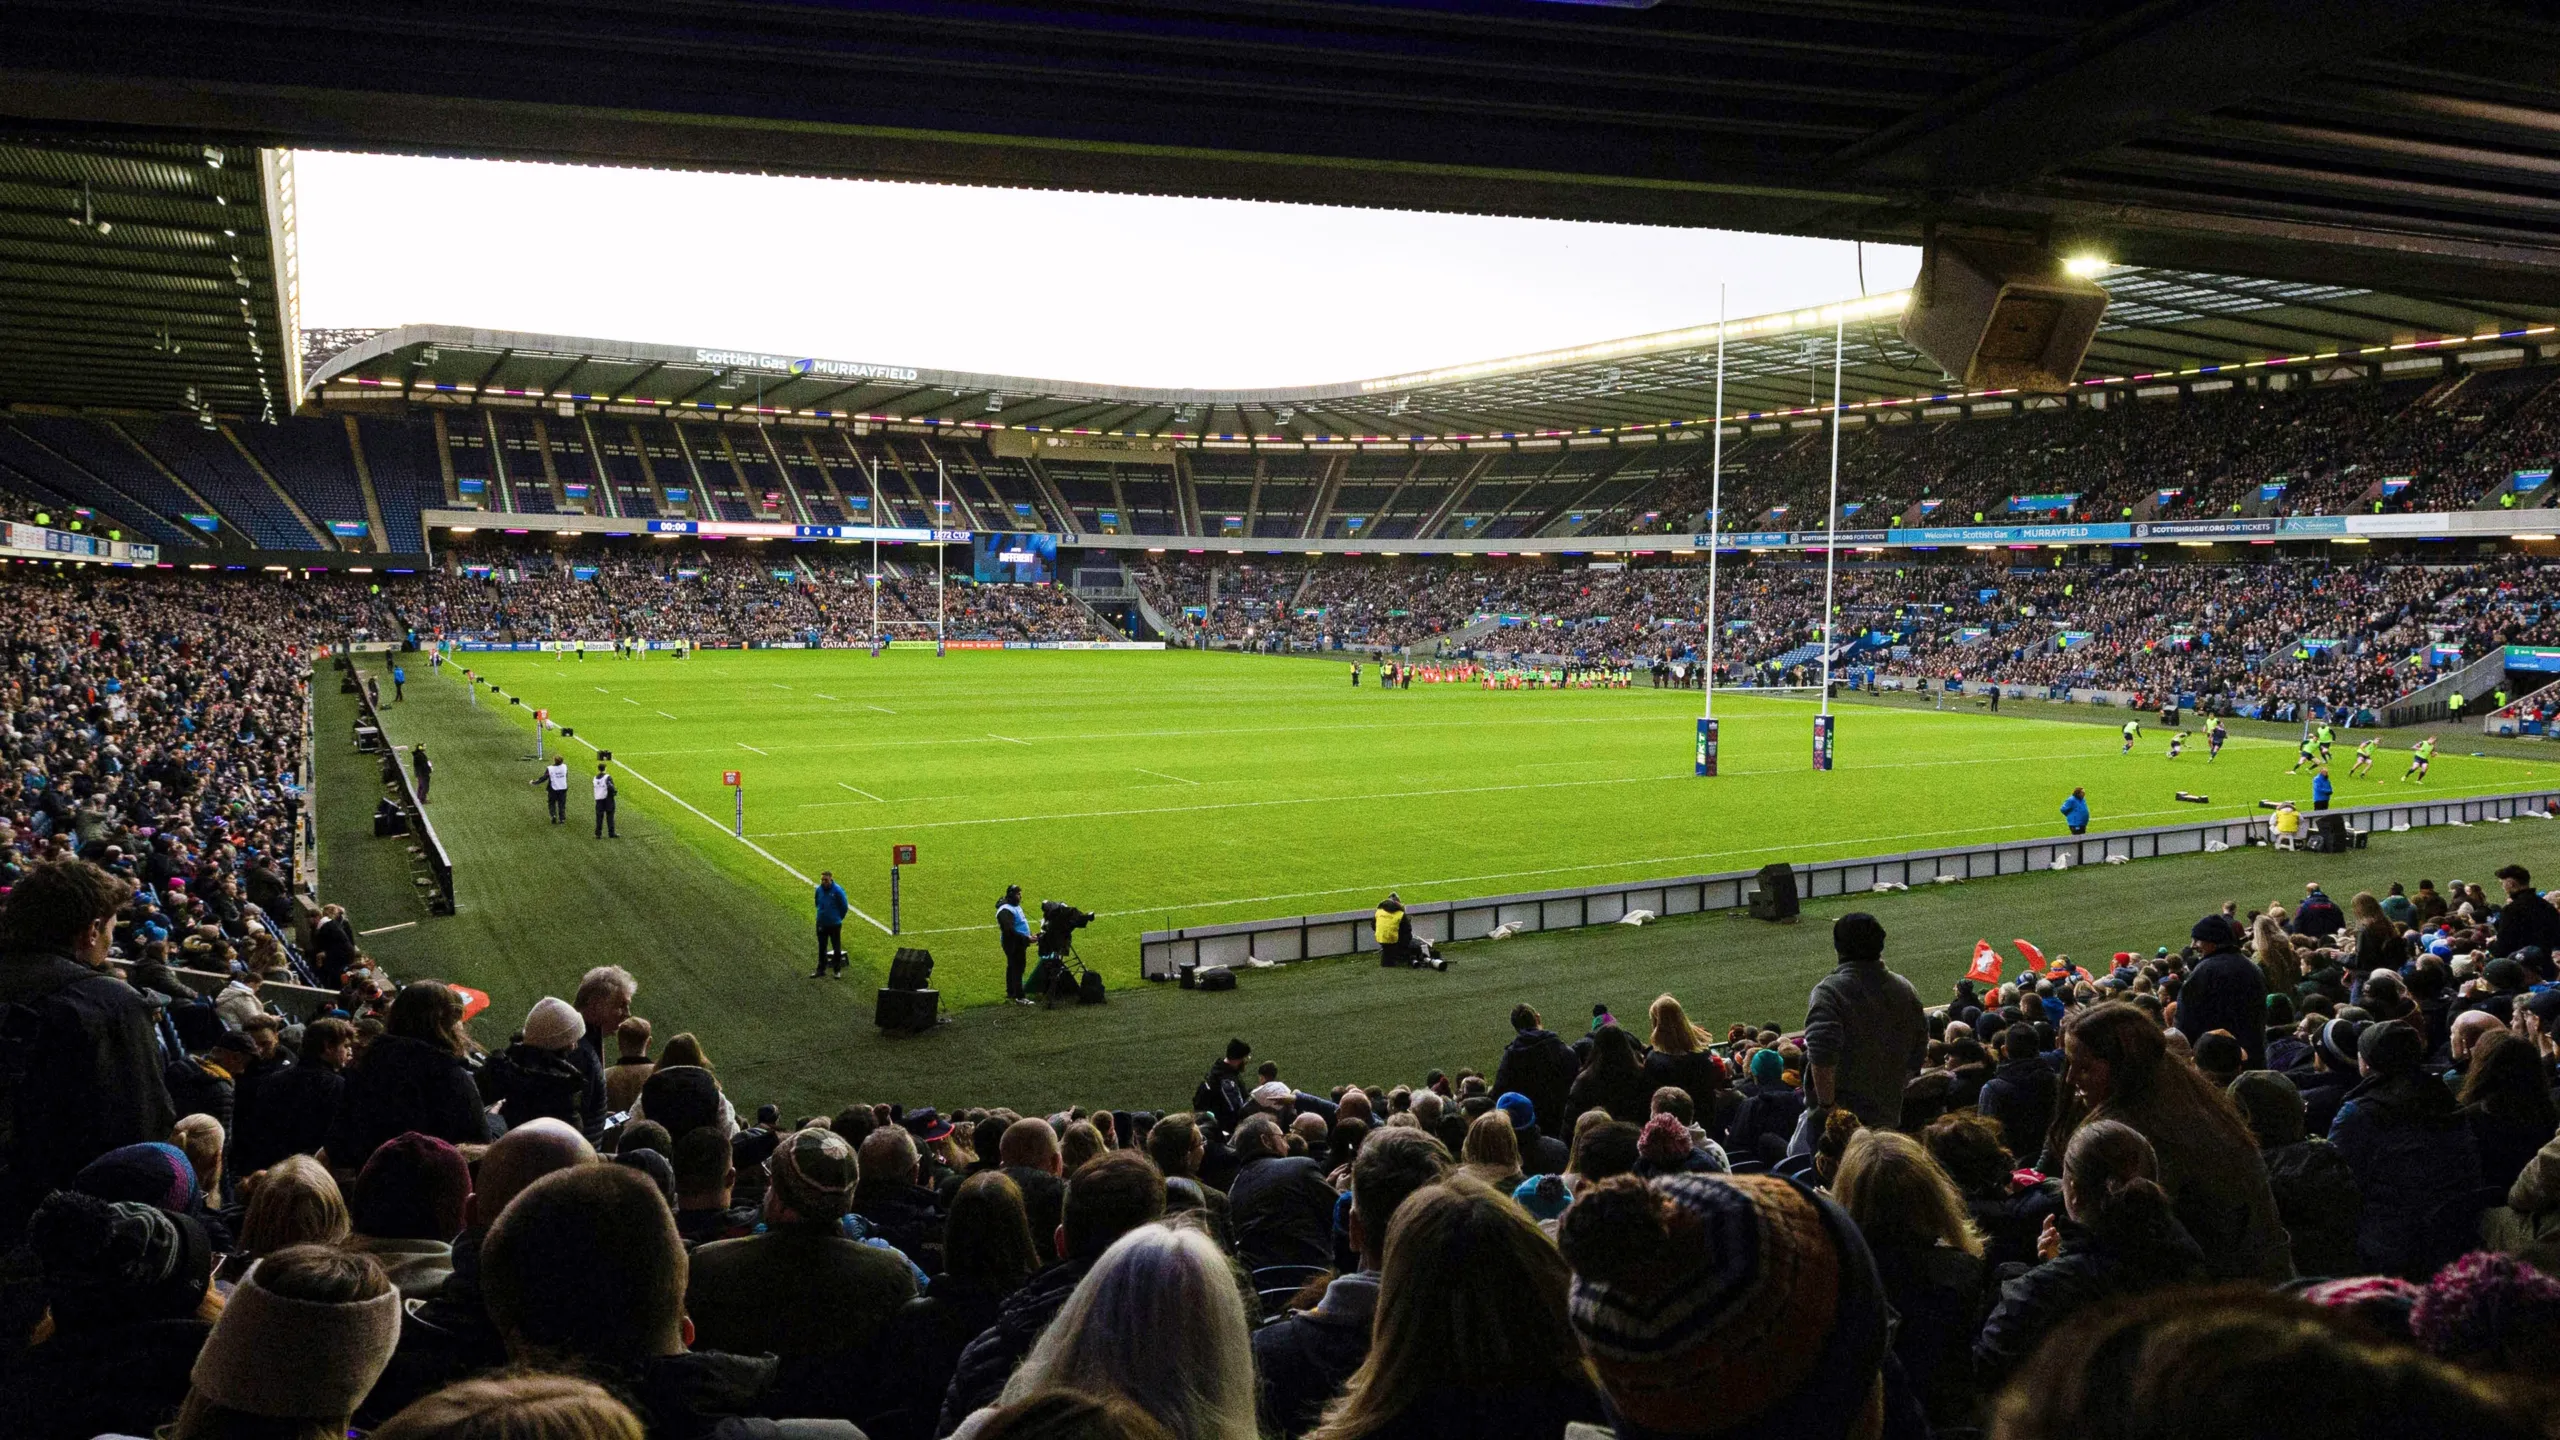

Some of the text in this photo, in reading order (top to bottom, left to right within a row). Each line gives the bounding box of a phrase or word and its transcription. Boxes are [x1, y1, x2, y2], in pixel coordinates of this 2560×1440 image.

[697, 349, 918, 381] Scottish Gas MURRAYFIELD
[660, 522, 687, 532] 00:00
[803, 526, 811, 536] 0
[827, 527, 834, 537] 0
[2152, 523, 2271, 534] SCOTTISHRUGBY.ORG FOR TICKETS
[952, 531, 971, 540] CUP
[1924, 531, 1953, 539] Welcome
[1962, 530, 1993, 539] Scottish
[1994, 530, 2008, 539] Gas
[2023, 528, 2088, 538] MURRAYFIELD
[999, 552, 1034, 563] DIFFERENT
[820, 641, 849, 649] QATAR
[1697, 732, 1706, 765] BKT
